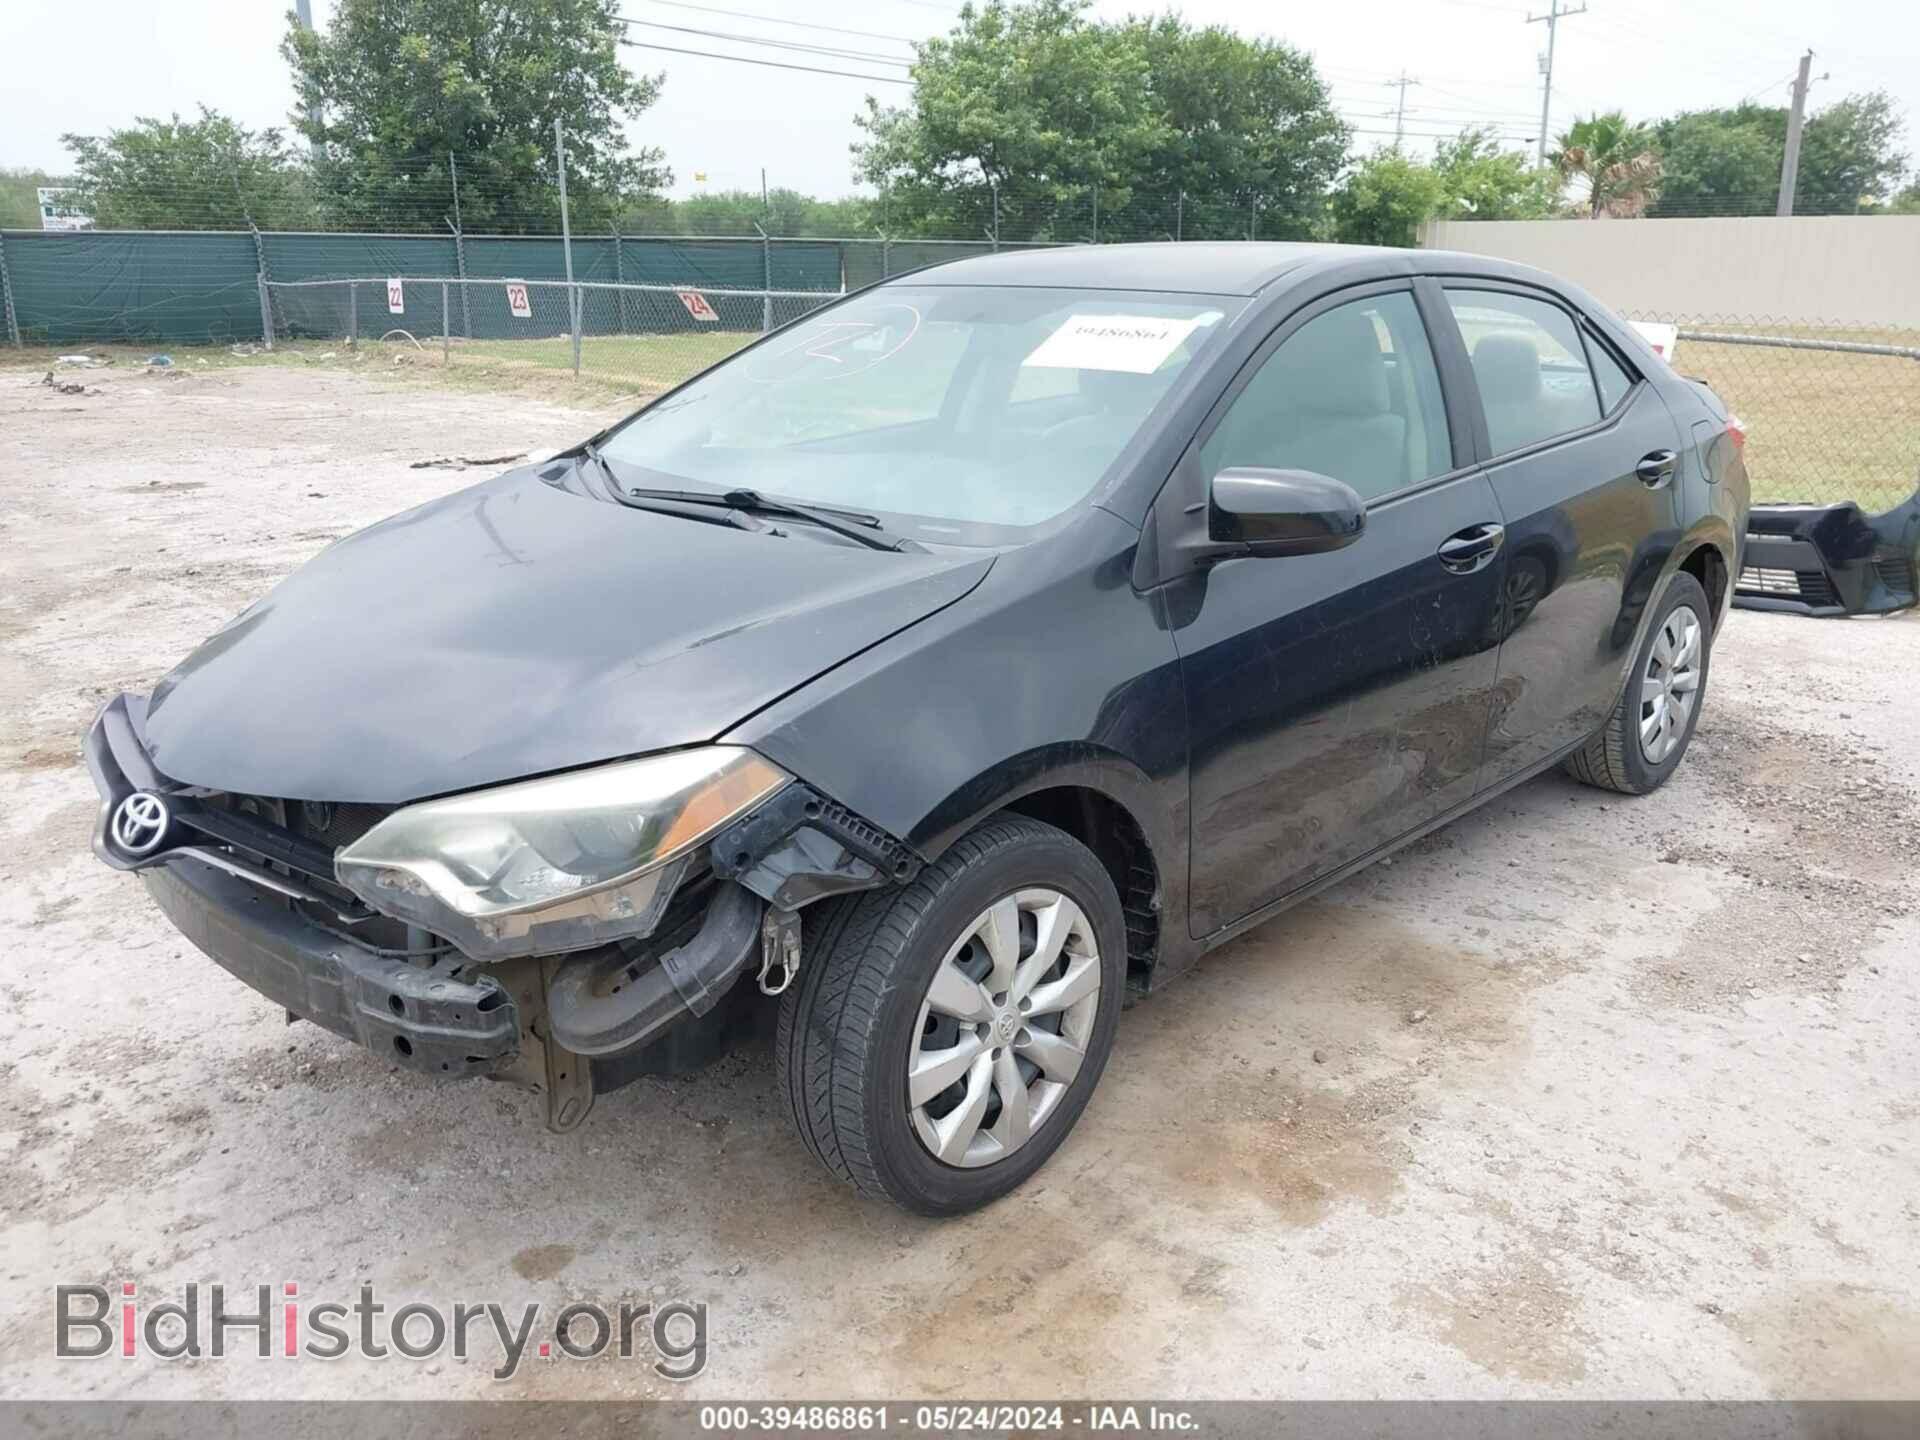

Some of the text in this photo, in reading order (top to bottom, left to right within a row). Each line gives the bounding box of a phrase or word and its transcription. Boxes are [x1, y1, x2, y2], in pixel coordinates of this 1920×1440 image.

[390, 287, 402, 307] 22
[511, 288, 528, 310] 23
[682, 294, 710, 314] 24
